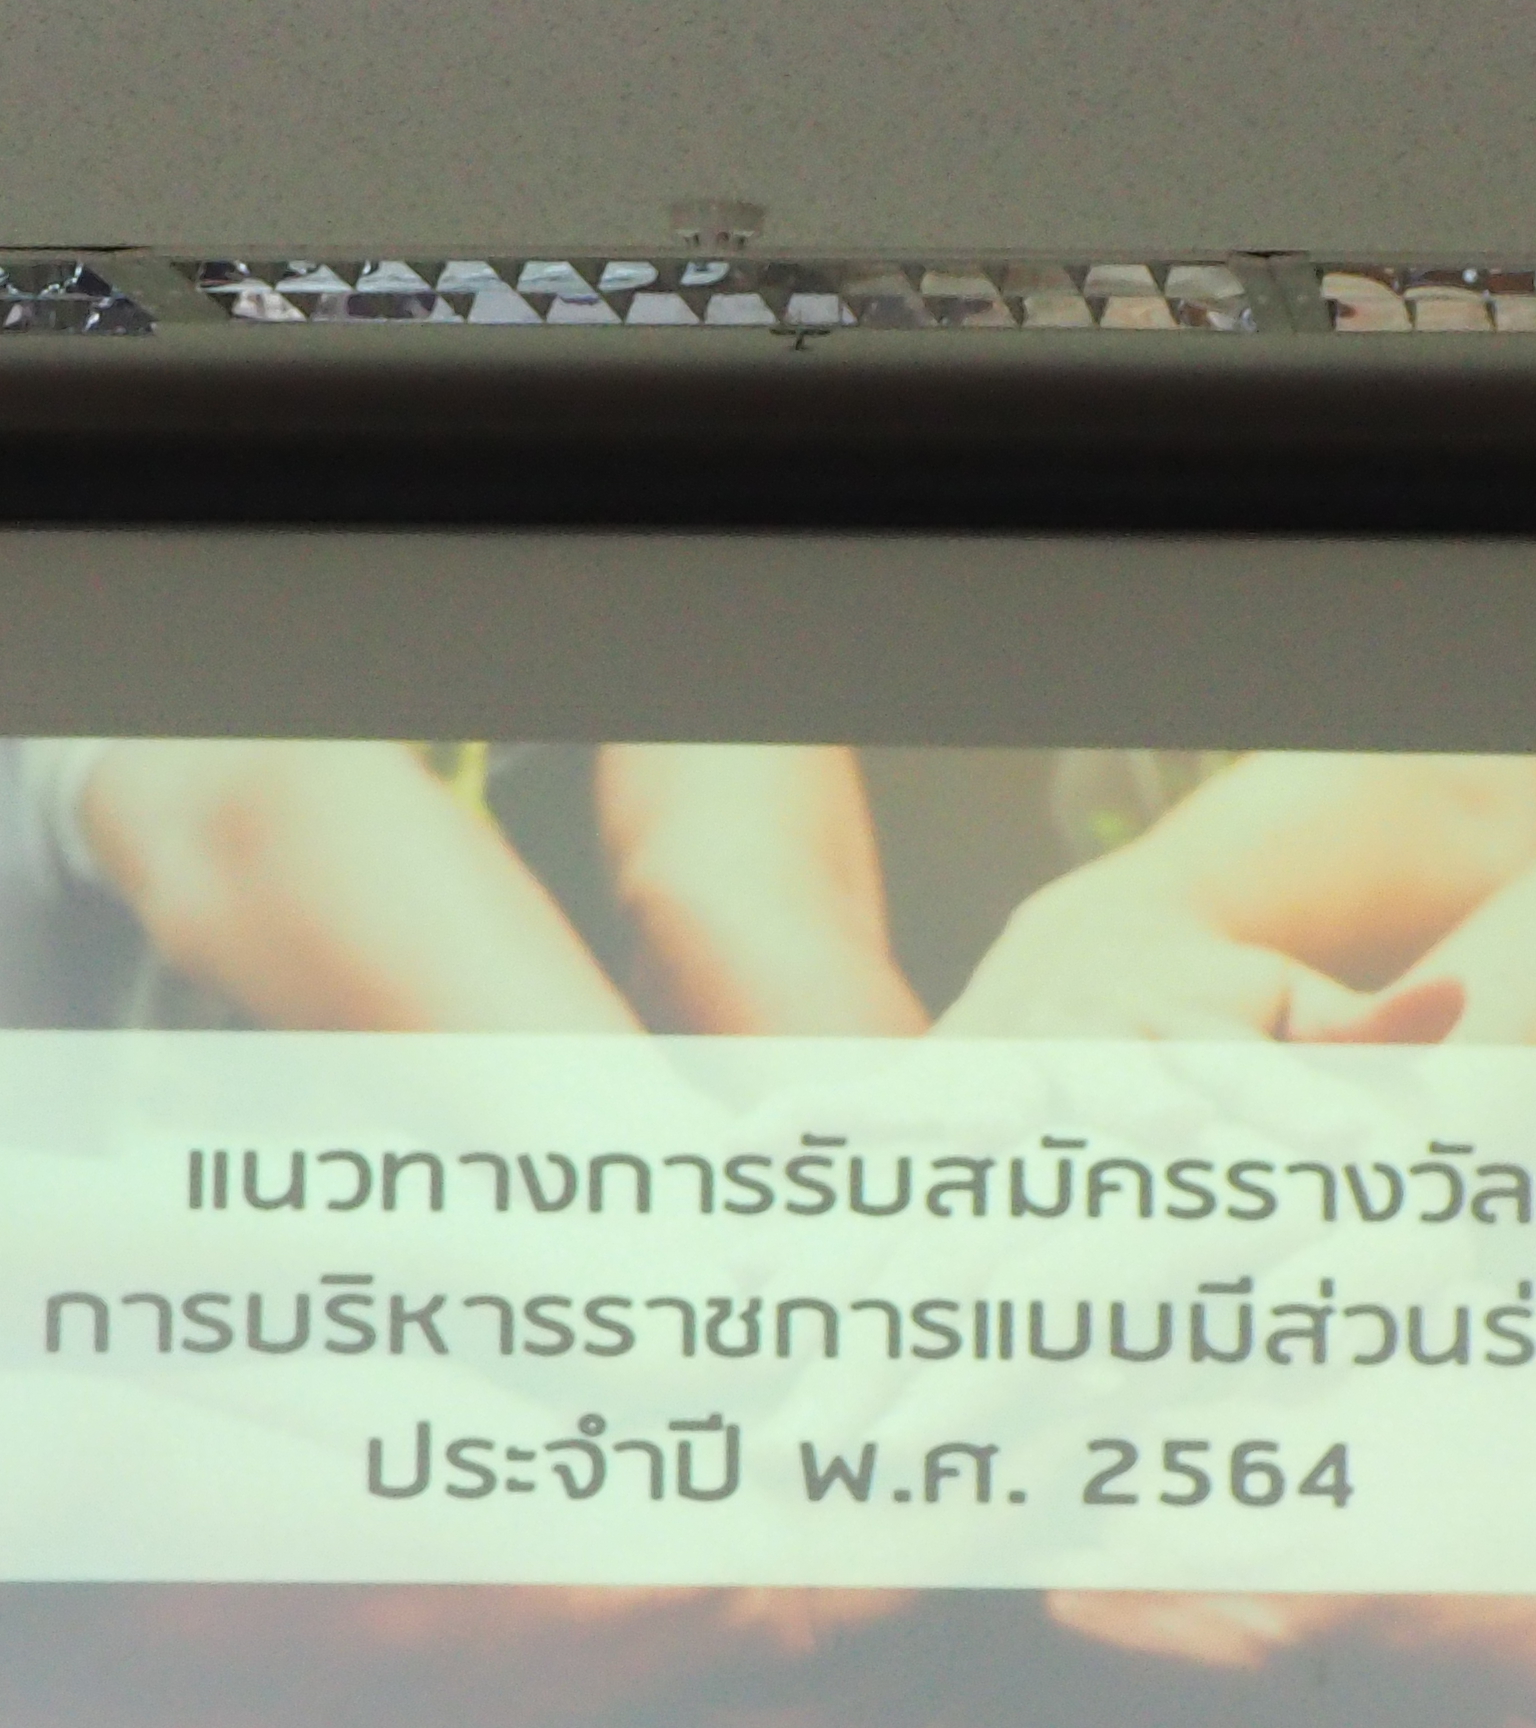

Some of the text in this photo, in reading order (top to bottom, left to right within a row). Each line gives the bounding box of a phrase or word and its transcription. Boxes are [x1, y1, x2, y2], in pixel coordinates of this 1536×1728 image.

[187, 1130, 1533, 1226] แนวทางการรับสมัครรางวัล
[366, 1411, 1355, 1510] ประจำปี พ.ศ. 2564
